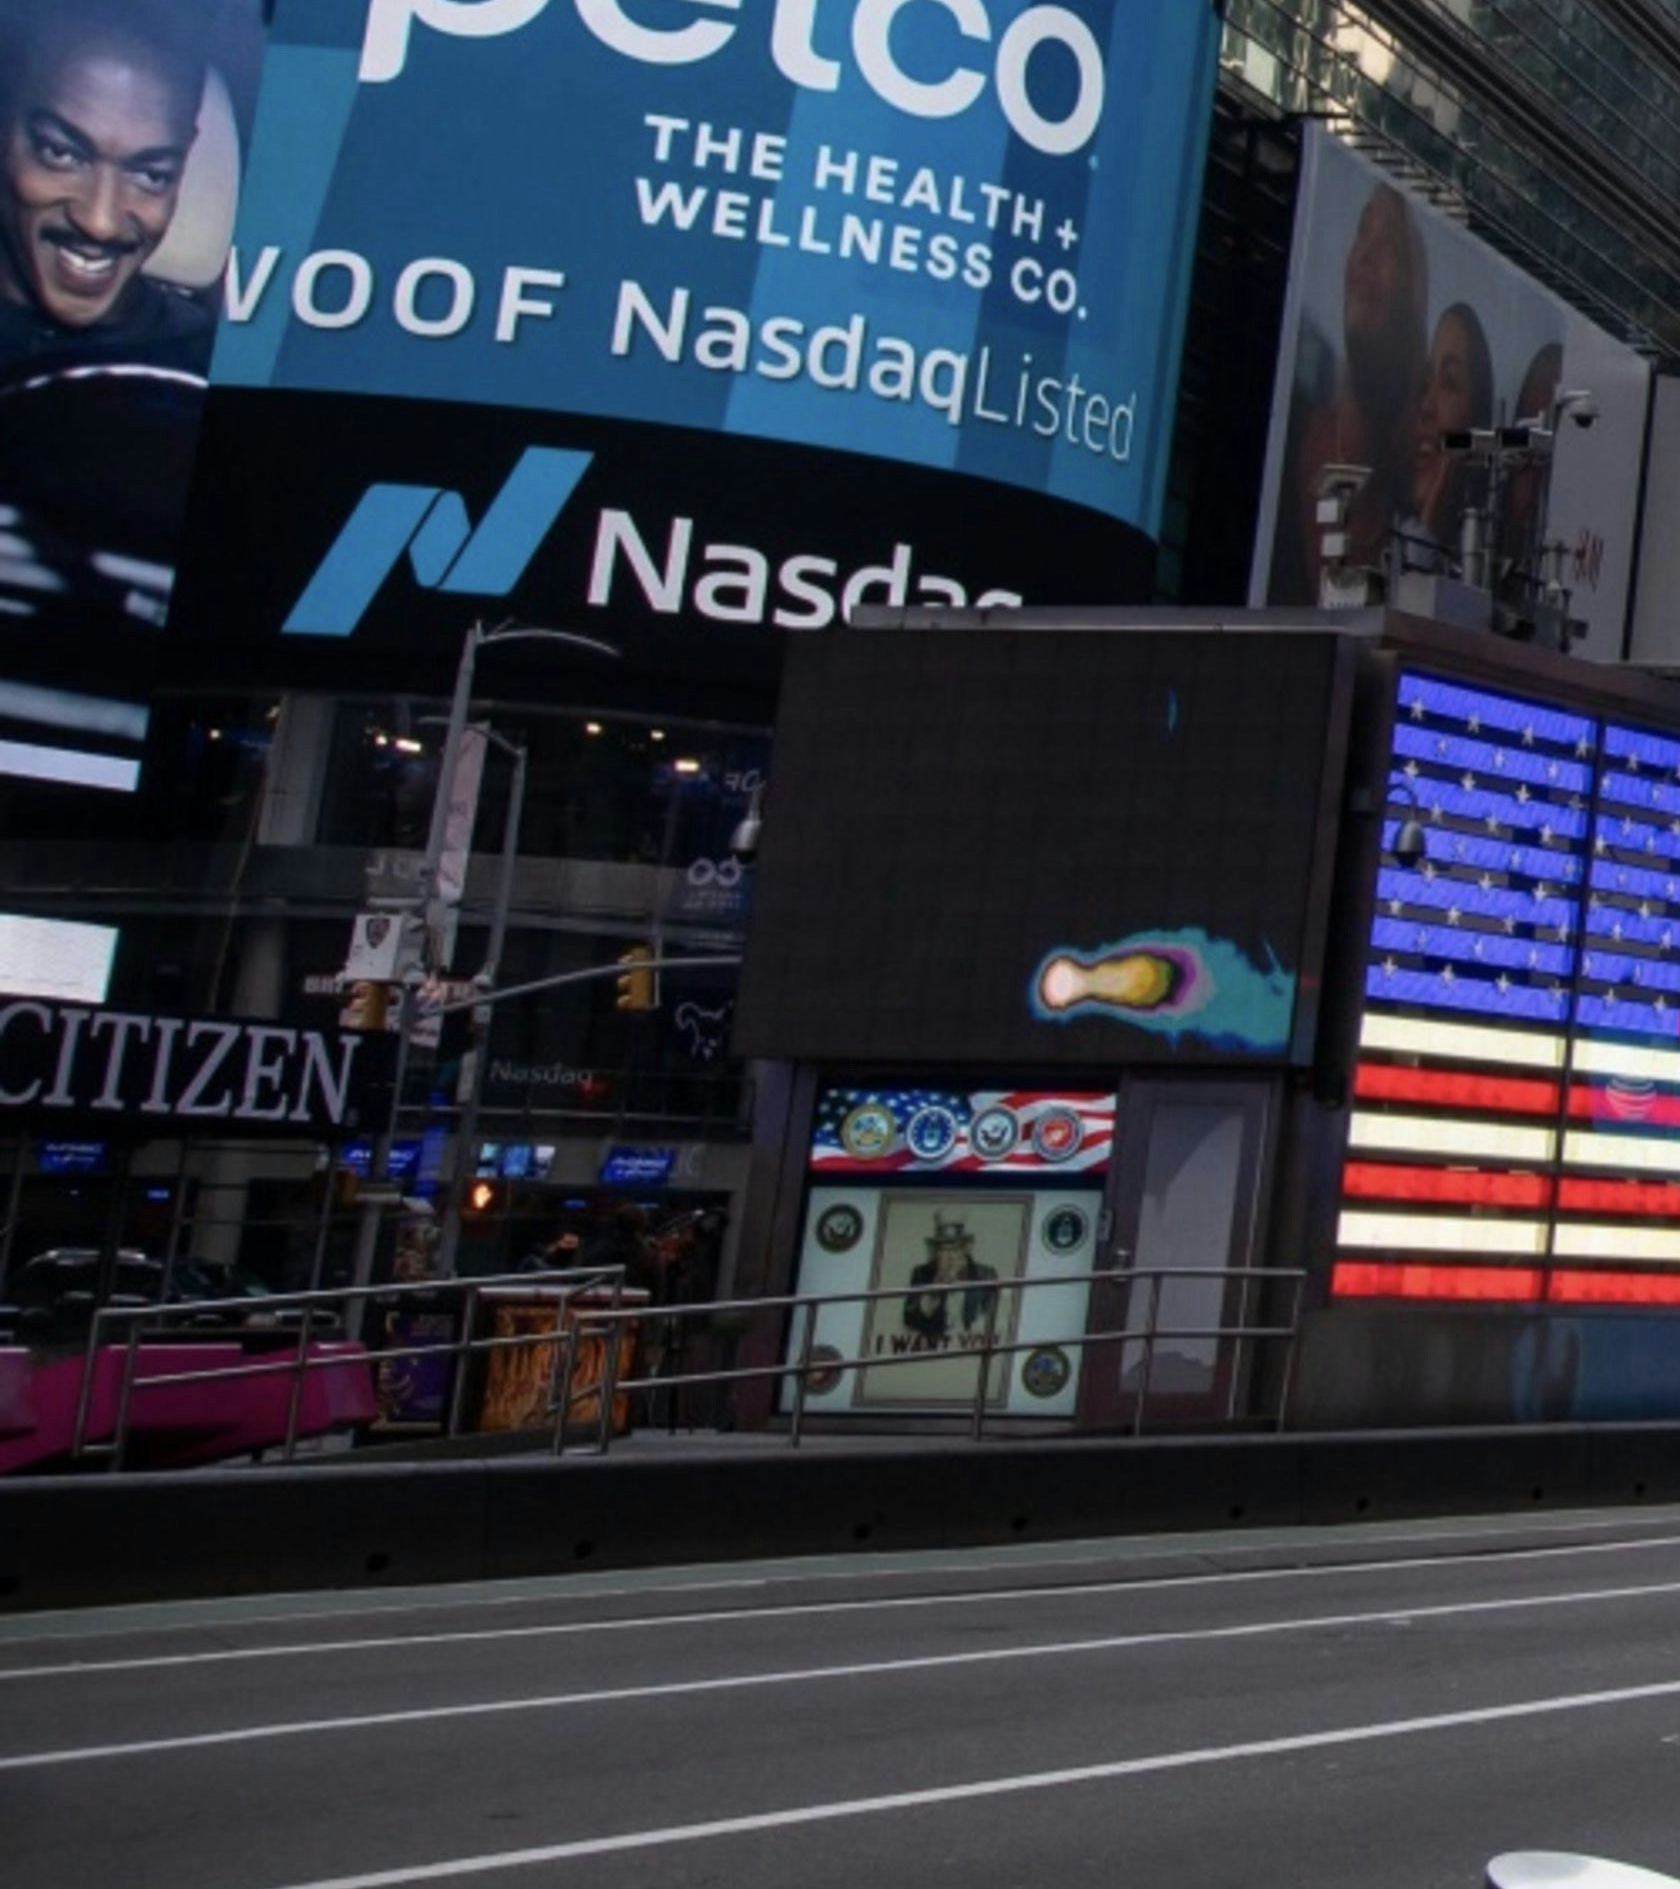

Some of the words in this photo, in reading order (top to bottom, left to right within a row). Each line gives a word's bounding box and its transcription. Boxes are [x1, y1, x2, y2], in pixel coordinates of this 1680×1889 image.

[644, 115, 785, 181] THE
[815, 145, 1045, 244] HEALTH
[634, 178, 993, 288] WELLNESS
[1008, 261, 1089, 320] CO.
[0, 1000, 362, 1125] CITIZEN
